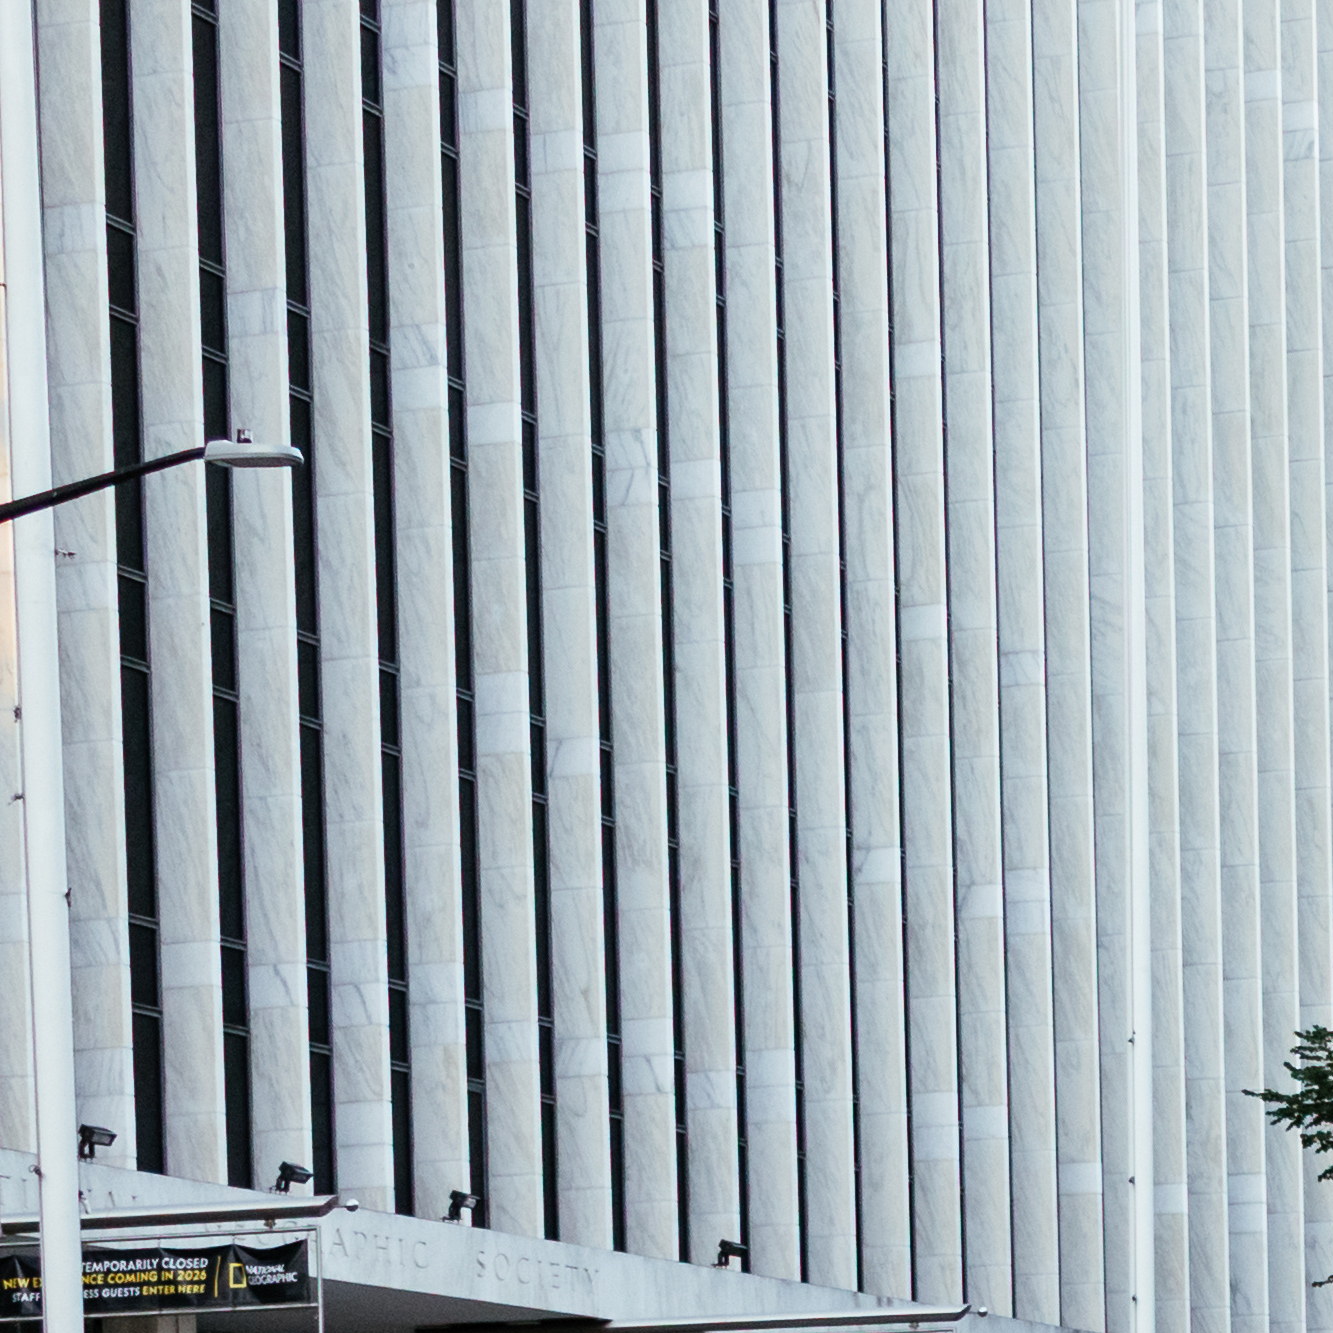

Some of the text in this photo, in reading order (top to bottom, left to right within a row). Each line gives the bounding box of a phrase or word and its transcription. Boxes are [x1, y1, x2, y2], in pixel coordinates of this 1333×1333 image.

[82, 1257, 208, 1273] TEMPORARILY CLOSED
[246, 1264, 285, 1275] NATIONAL
[3, 1278, 29, 1290] NEW
[107, 1271, 158, 1284] COMING
[161, 1271, 173, 1281] IN
[177, 1270, 207, 1281] 2026
[248, 1272, 298, 1285] GEOGRAPHIC
[12, 1292, 41, 1303] STAFF
[101, 1287, 140, 1298] GUESTS
[142, 1285, 175, 1296] ENTER
[178, 1284, 206, 1294] HERE
